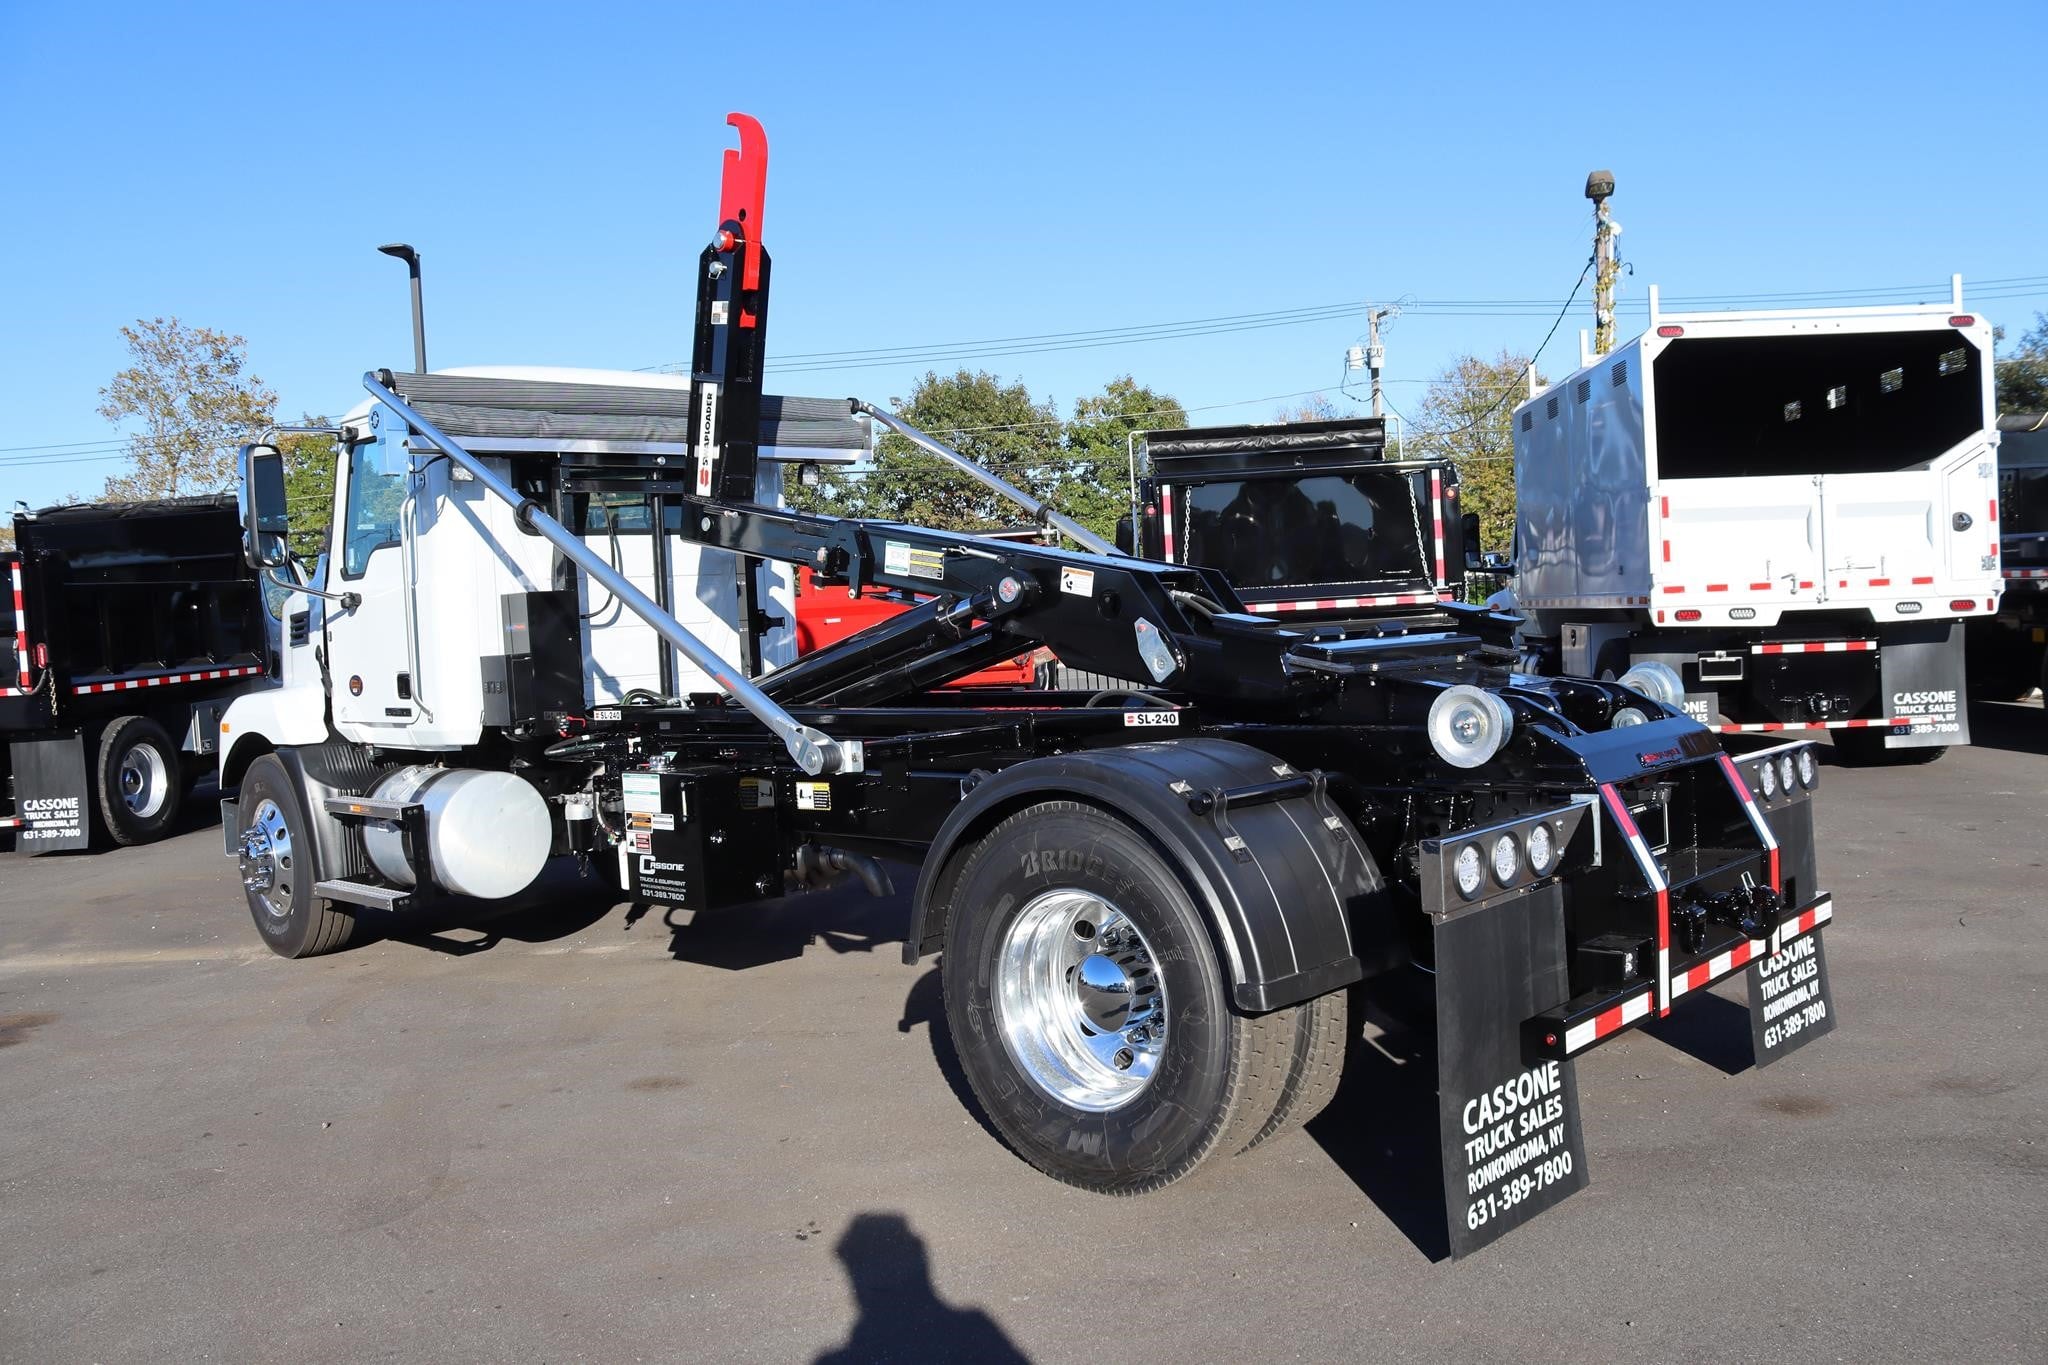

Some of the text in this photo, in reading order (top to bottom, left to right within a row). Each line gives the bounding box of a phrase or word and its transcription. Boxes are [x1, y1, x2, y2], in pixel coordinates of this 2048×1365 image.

[702, 393, 713, 466] SAPLOADER
[1137, 713, 1176, 725] SL-240
[1893, 690, 1957, 705] CASSONE
[1894, 703, 1956, 714] TRUCK SALES
[1893, 722, 1960, 735] 631-389-7800
[24, 797, 79, 812] CASSONE
[24, 809, 79, 820] TRUCK SALES
[23, 828, 81, 840] 631-389-7800
[639, 855, 685, 875] CASSONE
[1758, 935, 1816, 978] CASSONE
[1761, 957, 1818, 1000] TRUCK SALES
[1763, 979, 1819, 1022] RONKONKOMA, NY
[1764, 1000, 1826, 1048] 631-389-7800
[1463, 1060, 1561, 1135] CASSONE
[1465, 1095, 1563, 1165] TRUCK SALES
[1467, 1123, 1565, 1195] RONKONKOMA, NY
[1467, 1151, 1573, 1230] 631-389-7800
